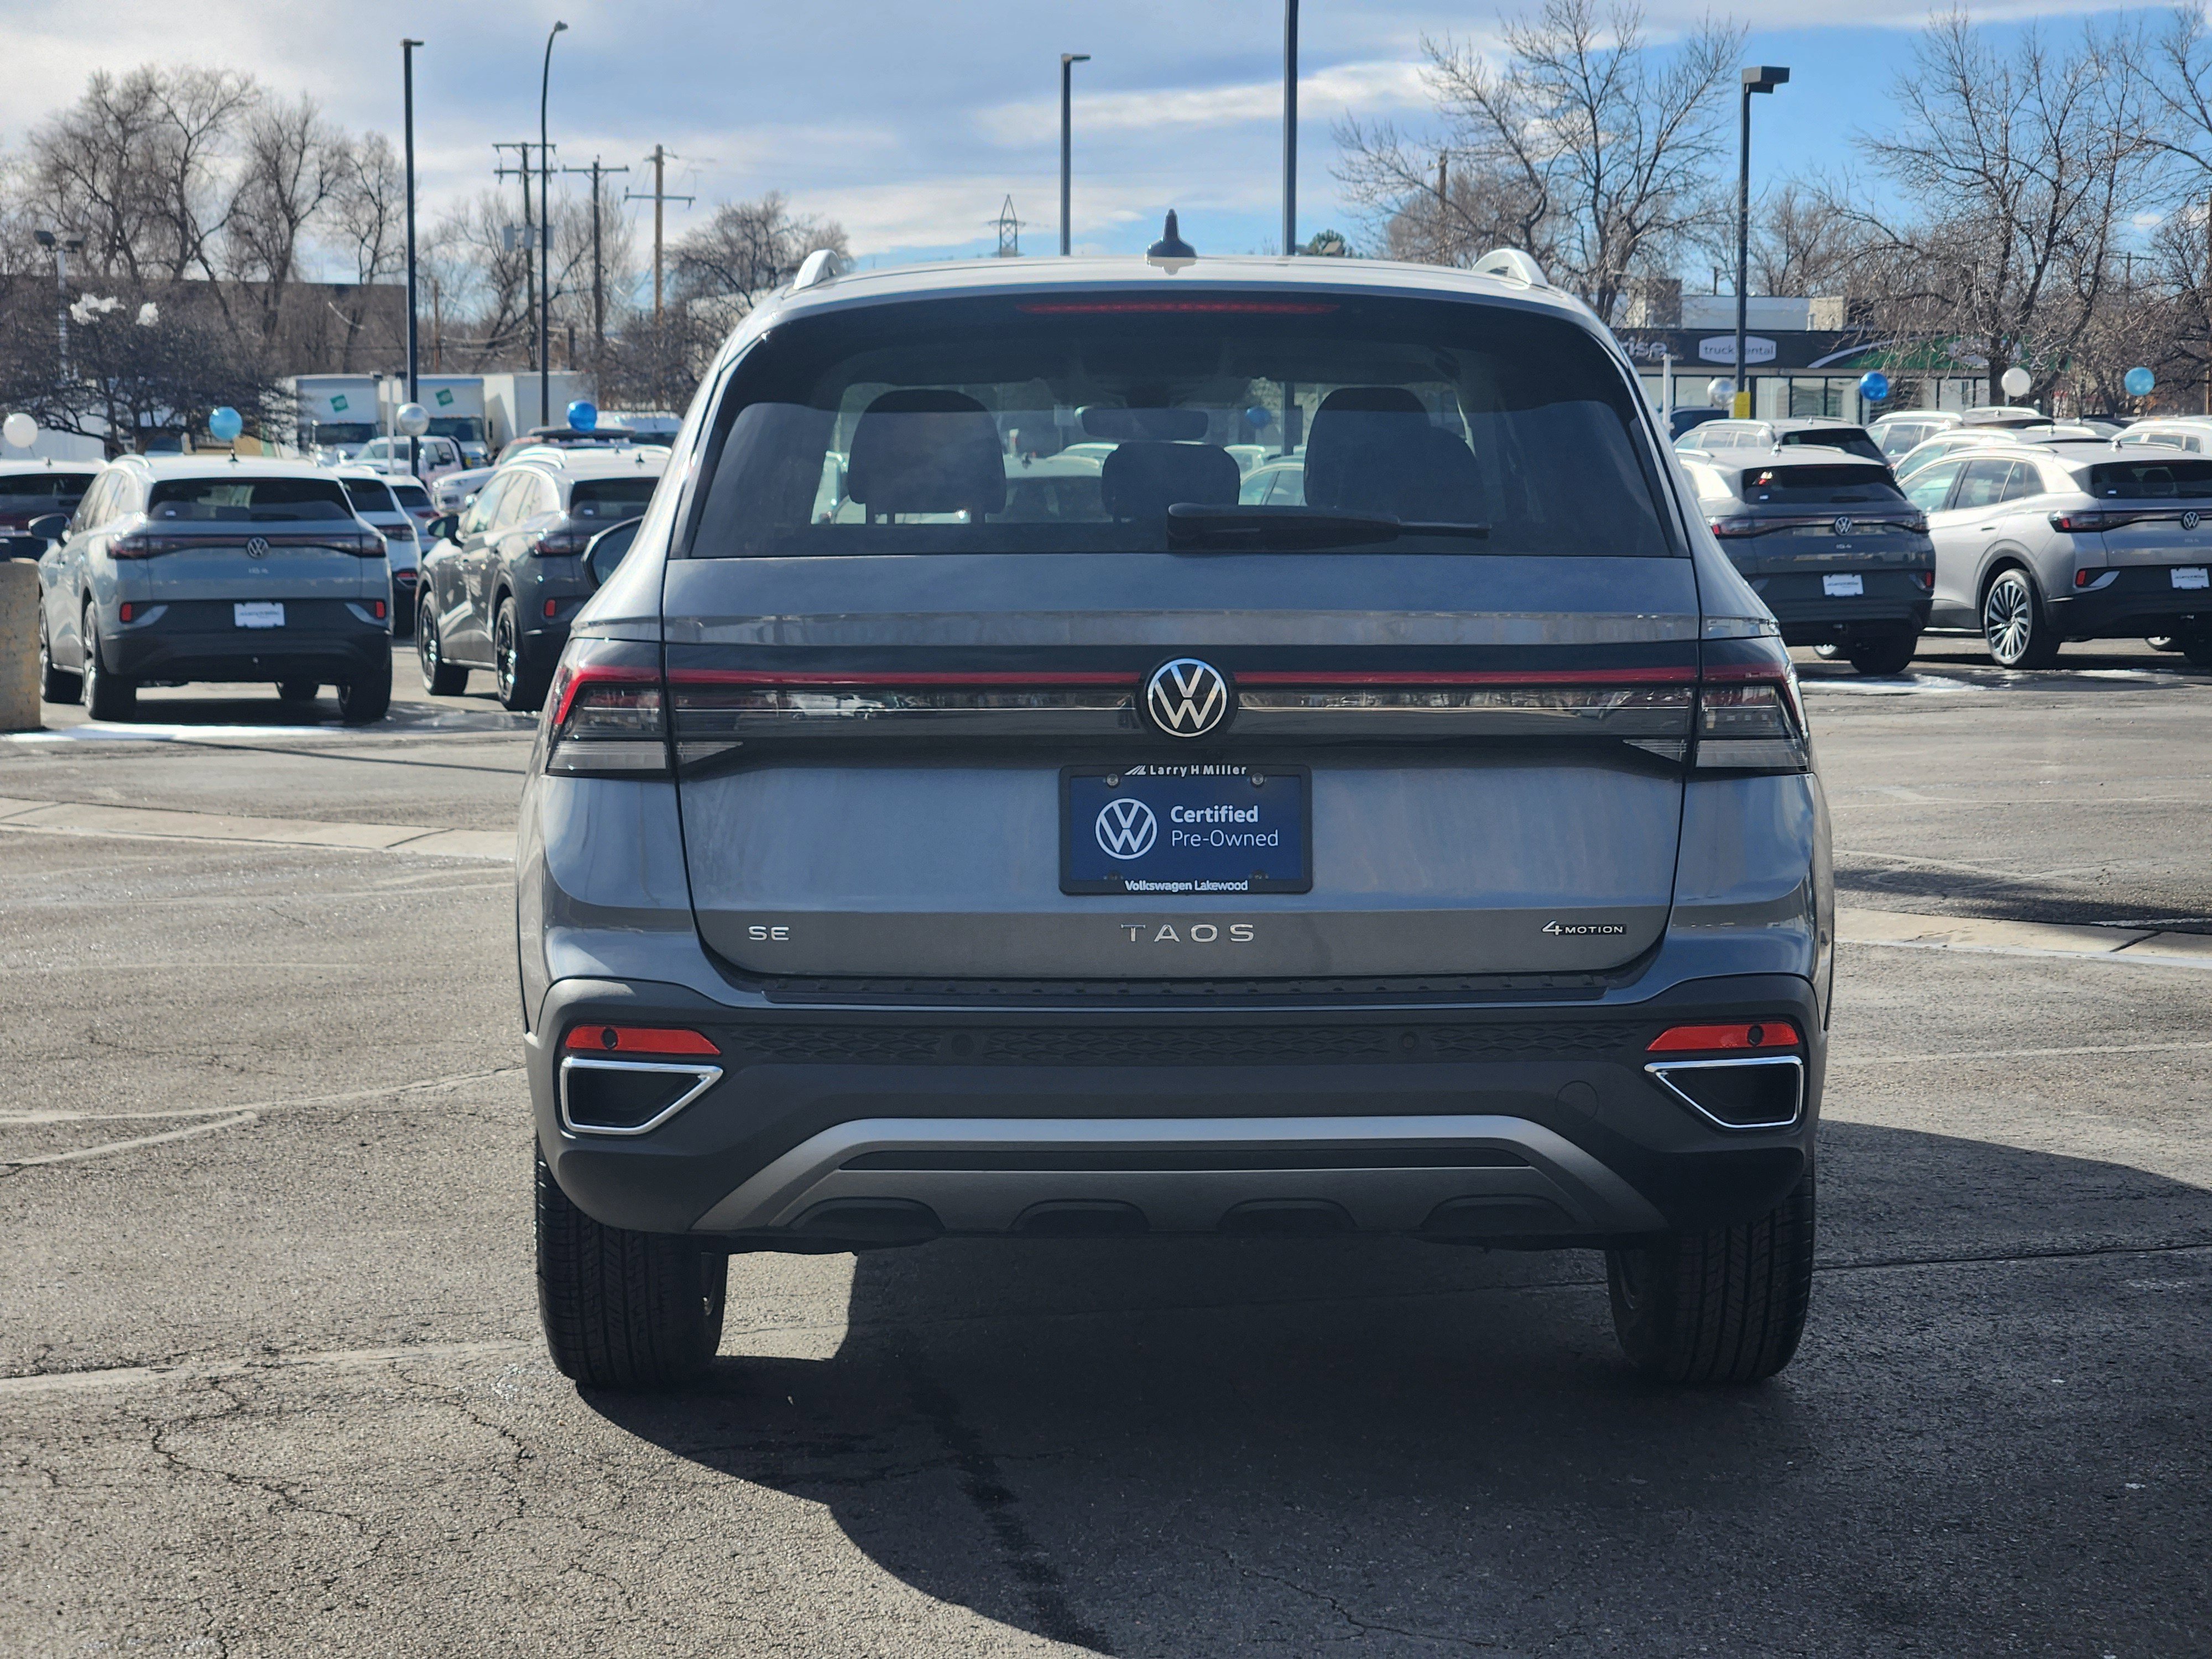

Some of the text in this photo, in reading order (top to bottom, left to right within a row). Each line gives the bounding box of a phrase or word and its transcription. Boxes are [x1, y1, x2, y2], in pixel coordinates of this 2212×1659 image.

[1704, 344, 1774, 355] truck ental
[1148, 658, 1227, 737] VW
[1150, 765, 1247, 777] Larry H Miller
[1170, 805, 1258, 823] Certified
[1095, 798, 1157, 859] VW
[1171, 830, 1279, 847] Pre-Owned
[1125, 880, 1248, 892] Volkswagen Lakewood
[748, 926, 789, 940] SE
[1121, 924, 1254, 942] TAOS
[1542, 920, 1623, 936] 4MOTION
